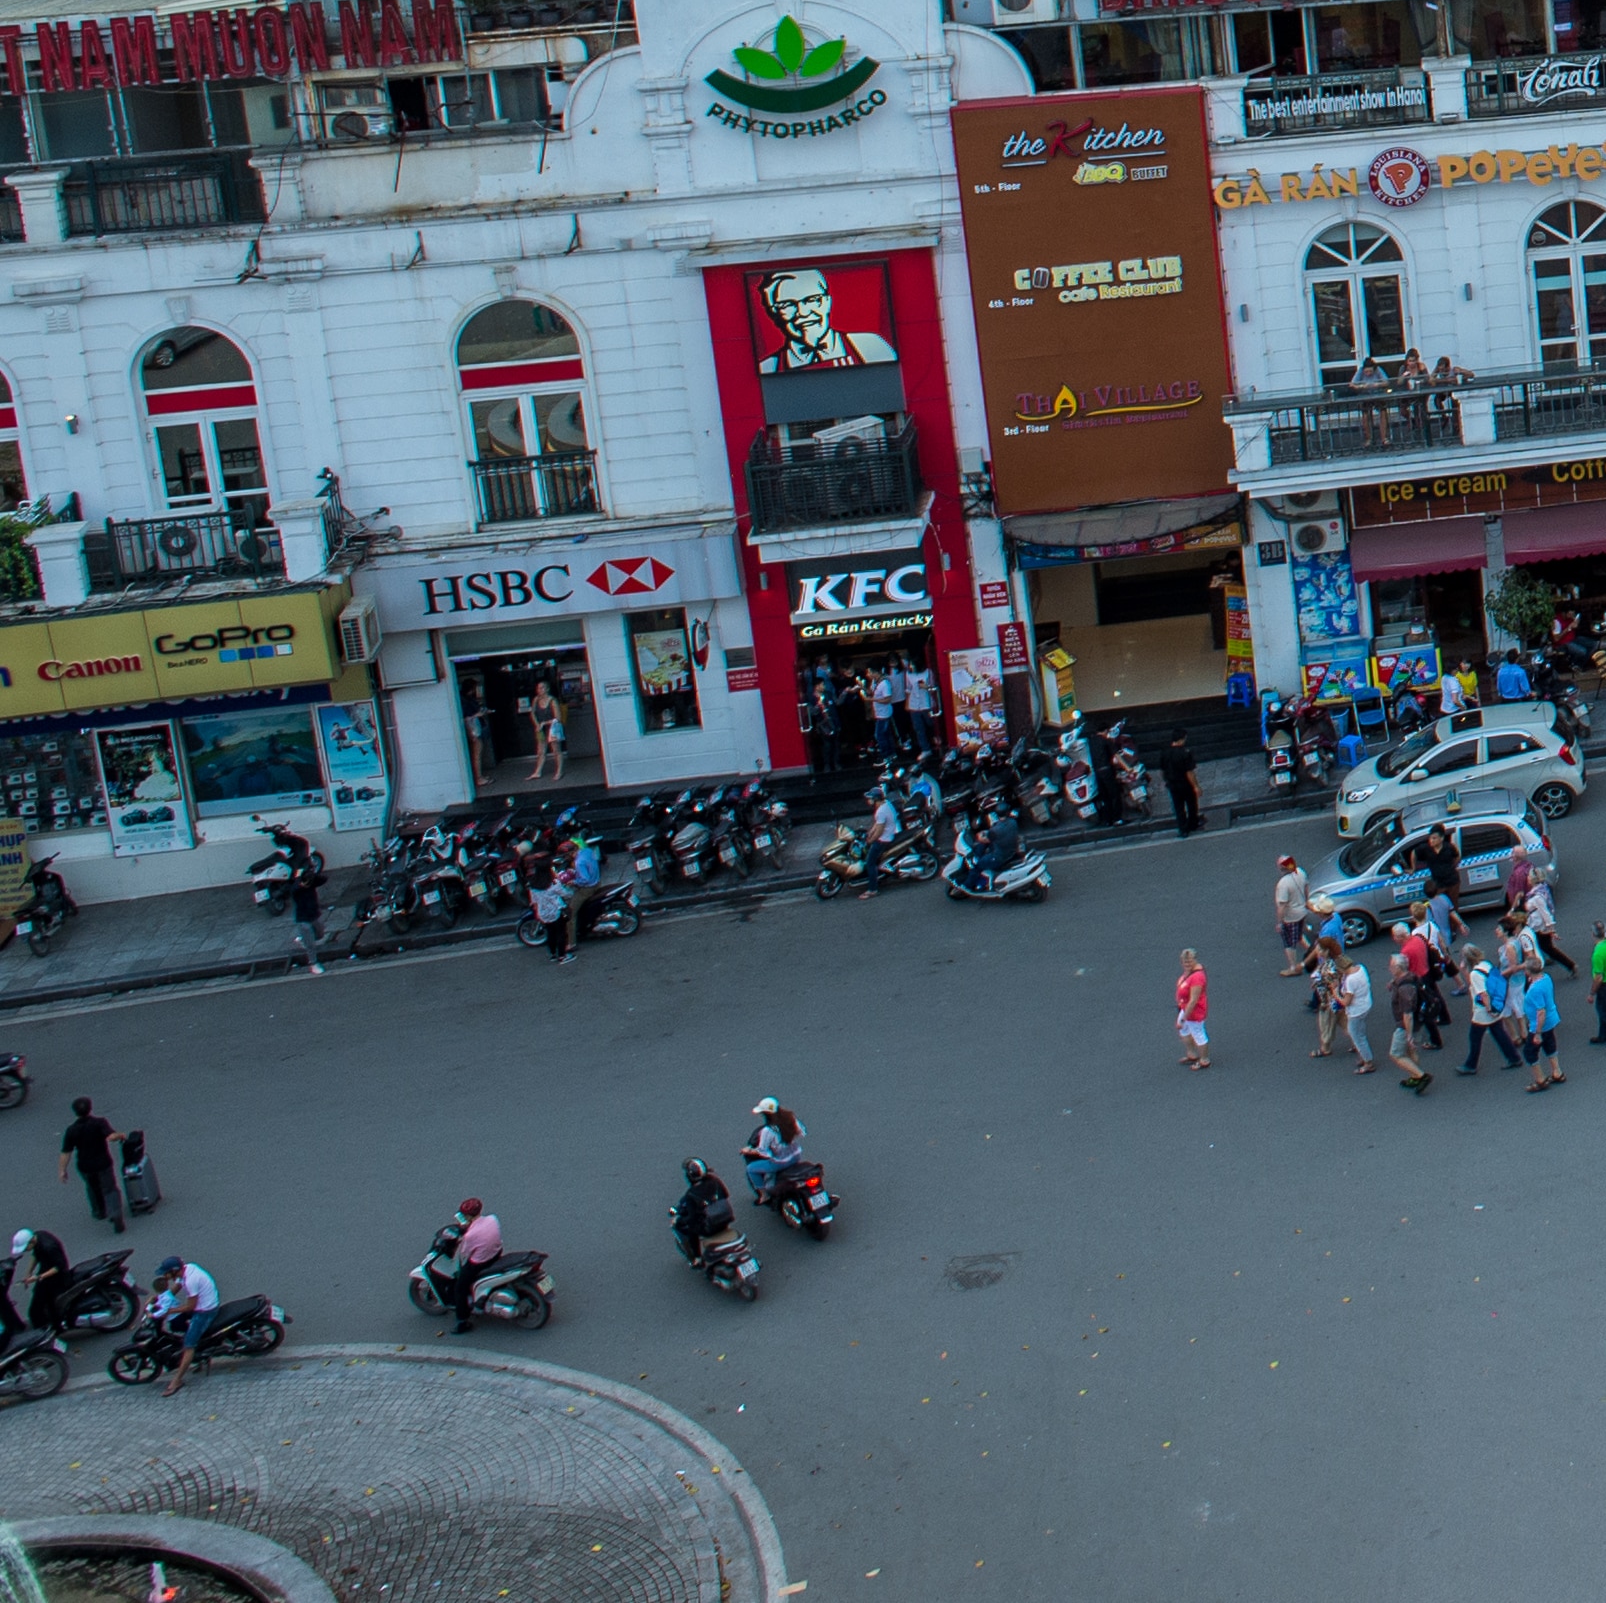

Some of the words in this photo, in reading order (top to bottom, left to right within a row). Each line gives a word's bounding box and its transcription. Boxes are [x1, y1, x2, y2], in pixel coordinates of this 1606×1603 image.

[35, 14, 161, 93] NAM
[705, 89, 888, 139] PHYTOPHARCO
[1248, 99, 1266, 120] The
[1267, 96, 1290, 119] best
[1291, 89, 1360, 116] entertainment
[1360, 88, 1386, 109] show
[1386, 86, 1396, 108] in
[1397, 83, 1426, 106] Hanoi
[1002, 130, 1047, 158] the
[1046, 116, 1166, 159] Kitchen
[1131, 165, 1168, 181] BUFFET
[1370, 150, 1427, 177] LOUISIANA
[974, 184, 991, 194] 5th
[998, 181, 1022, 192] Floor
[1213, 168, 1272, 210] GÀ
[1280, 162, 1359, 204] RÁN
[1375, 184, 1427, 206] KITCHEN
[1117, 255, 1183, 282] CLUB
[988, 299, 1004, 309] 4th
[1012, 297, 1034, 307] Floor
[1099, 278, 1183, 301] Restaurant
[1094, 380, 1200, 408] VILLAGE
[1004, 425, 1019, 436] 3rd
[1026, 423, 1050, 434] Floor
[1379, 480, 1417, 503] Ice
[1433, 471, 1507, 498] cream
[1260, 542, 1283, 560] 3B
[418, 564, 574, 616] HSBC
[795, 564, 926, 615] KFC
[827, 621, 860, 636] Rán
[860, 613, 934, 633] Kentucky
[155, 624, 295, 655] GoPro
[37, 653, 143, 681] Canon
